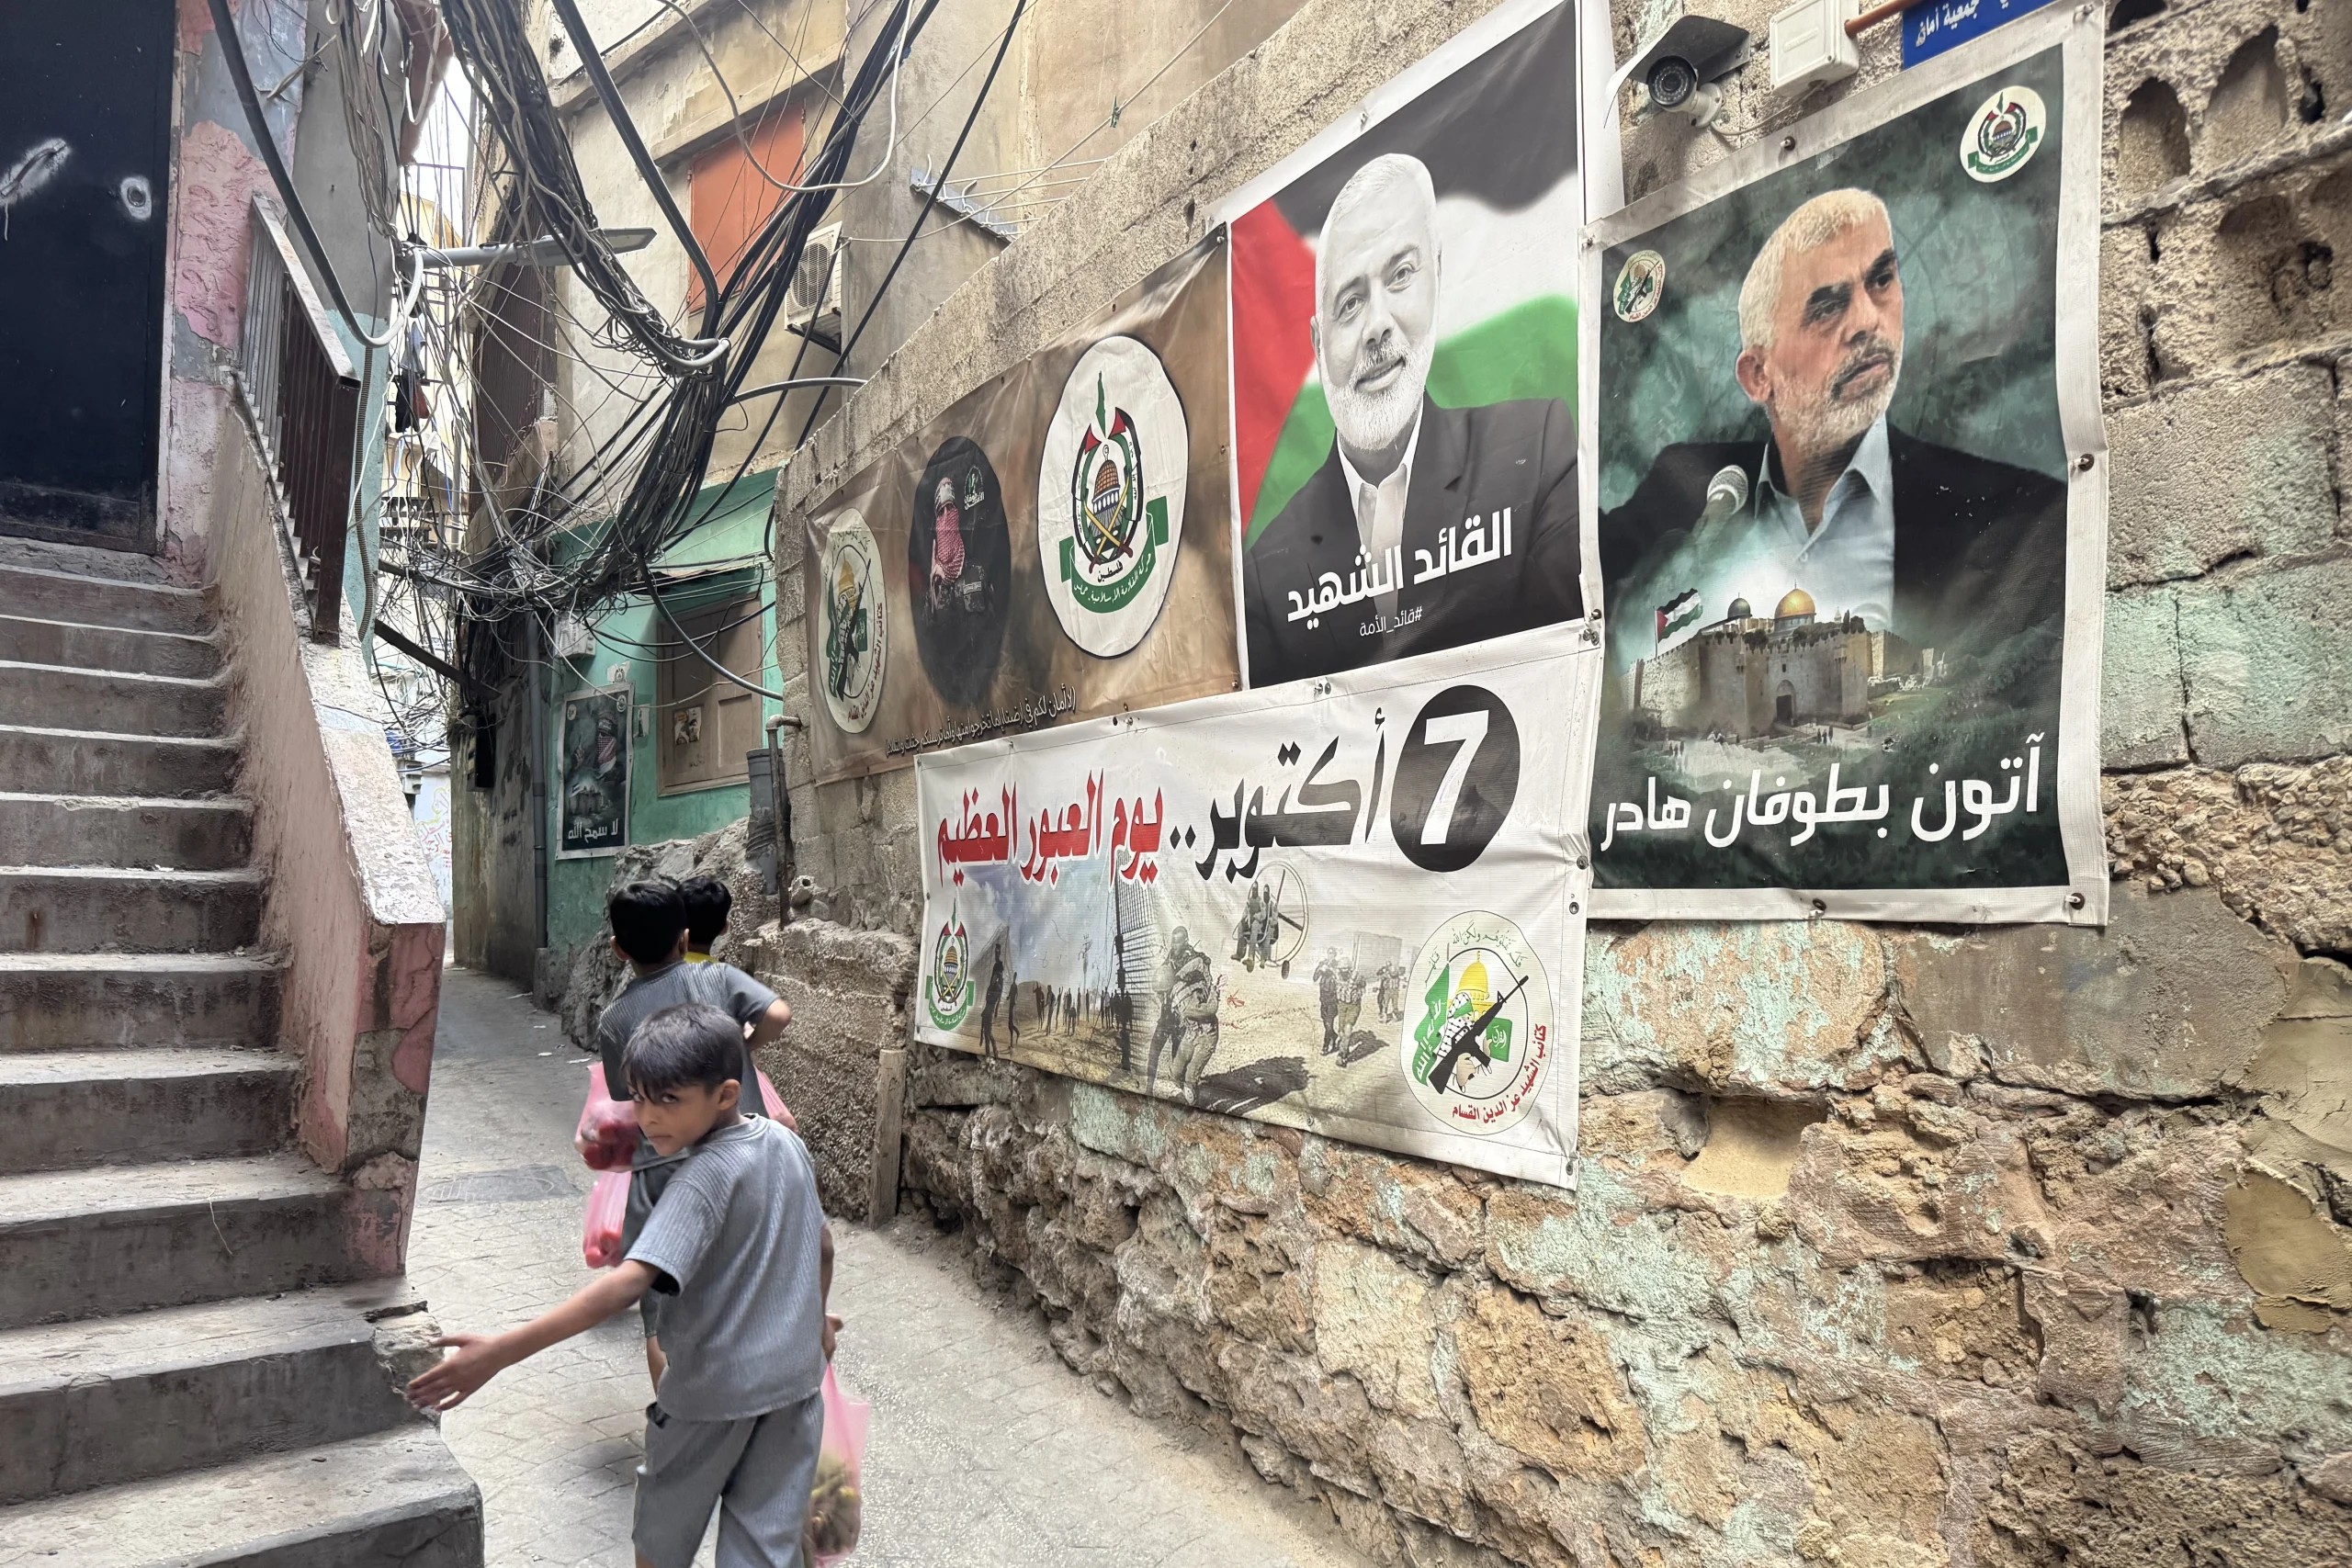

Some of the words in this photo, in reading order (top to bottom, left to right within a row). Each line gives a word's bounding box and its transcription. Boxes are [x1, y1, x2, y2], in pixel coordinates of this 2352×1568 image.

[1414, 507, 1511, 584] القائد
[1098, 560, 1124, 582] فلسطين
[1287, 544, 1404, 630] الشهيد
[1359, 605, 1423, 637] #قائد_الأمة
[1023, 697, 1034, 728] في
[1034, 695, 1046, 726] لكم
[1419, 709, 1489, 845] 7
[1910, 732, 2046, 841] آتون
[1600, 776, 1690, 852] هادر
[1705, 762, 1889, 848] بطوفان
[569, 821, 582, 840] الله
[584, 826, 607, 843] سمح
[611, 818, 618, 835] لا
[937, 781, 1019, 887] العظيم
[1019, 768, 1104, 885] العبور
[1110, 786, 1164, 885] يوم
[1532, 1023, 1546, 1059] كتائب
[1521, 1058, 1541, 1096] الشهيد
[1453, 1104, 1480, 1120] القسام
[1483, 1100, 1507, 1123] الدين
[1506, 1093, 1521, 1111] عز
